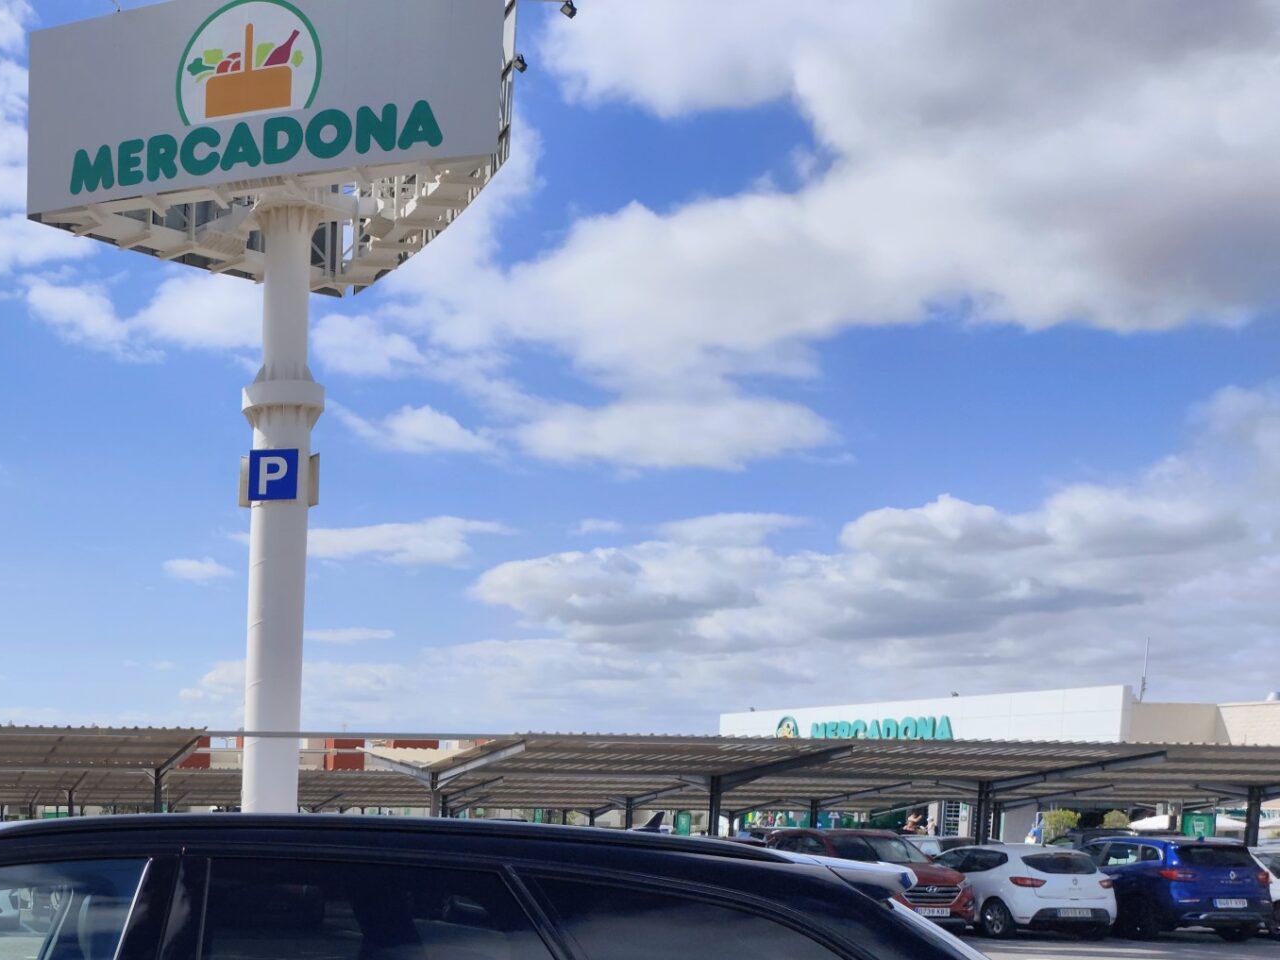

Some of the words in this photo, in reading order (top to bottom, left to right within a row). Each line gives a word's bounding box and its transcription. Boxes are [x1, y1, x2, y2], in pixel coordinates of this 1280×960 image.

[70, 100, 443, 195] MERCADONA
[258, 456, 288, 495] P
[811, 715, 954, 740] MERCADONA
